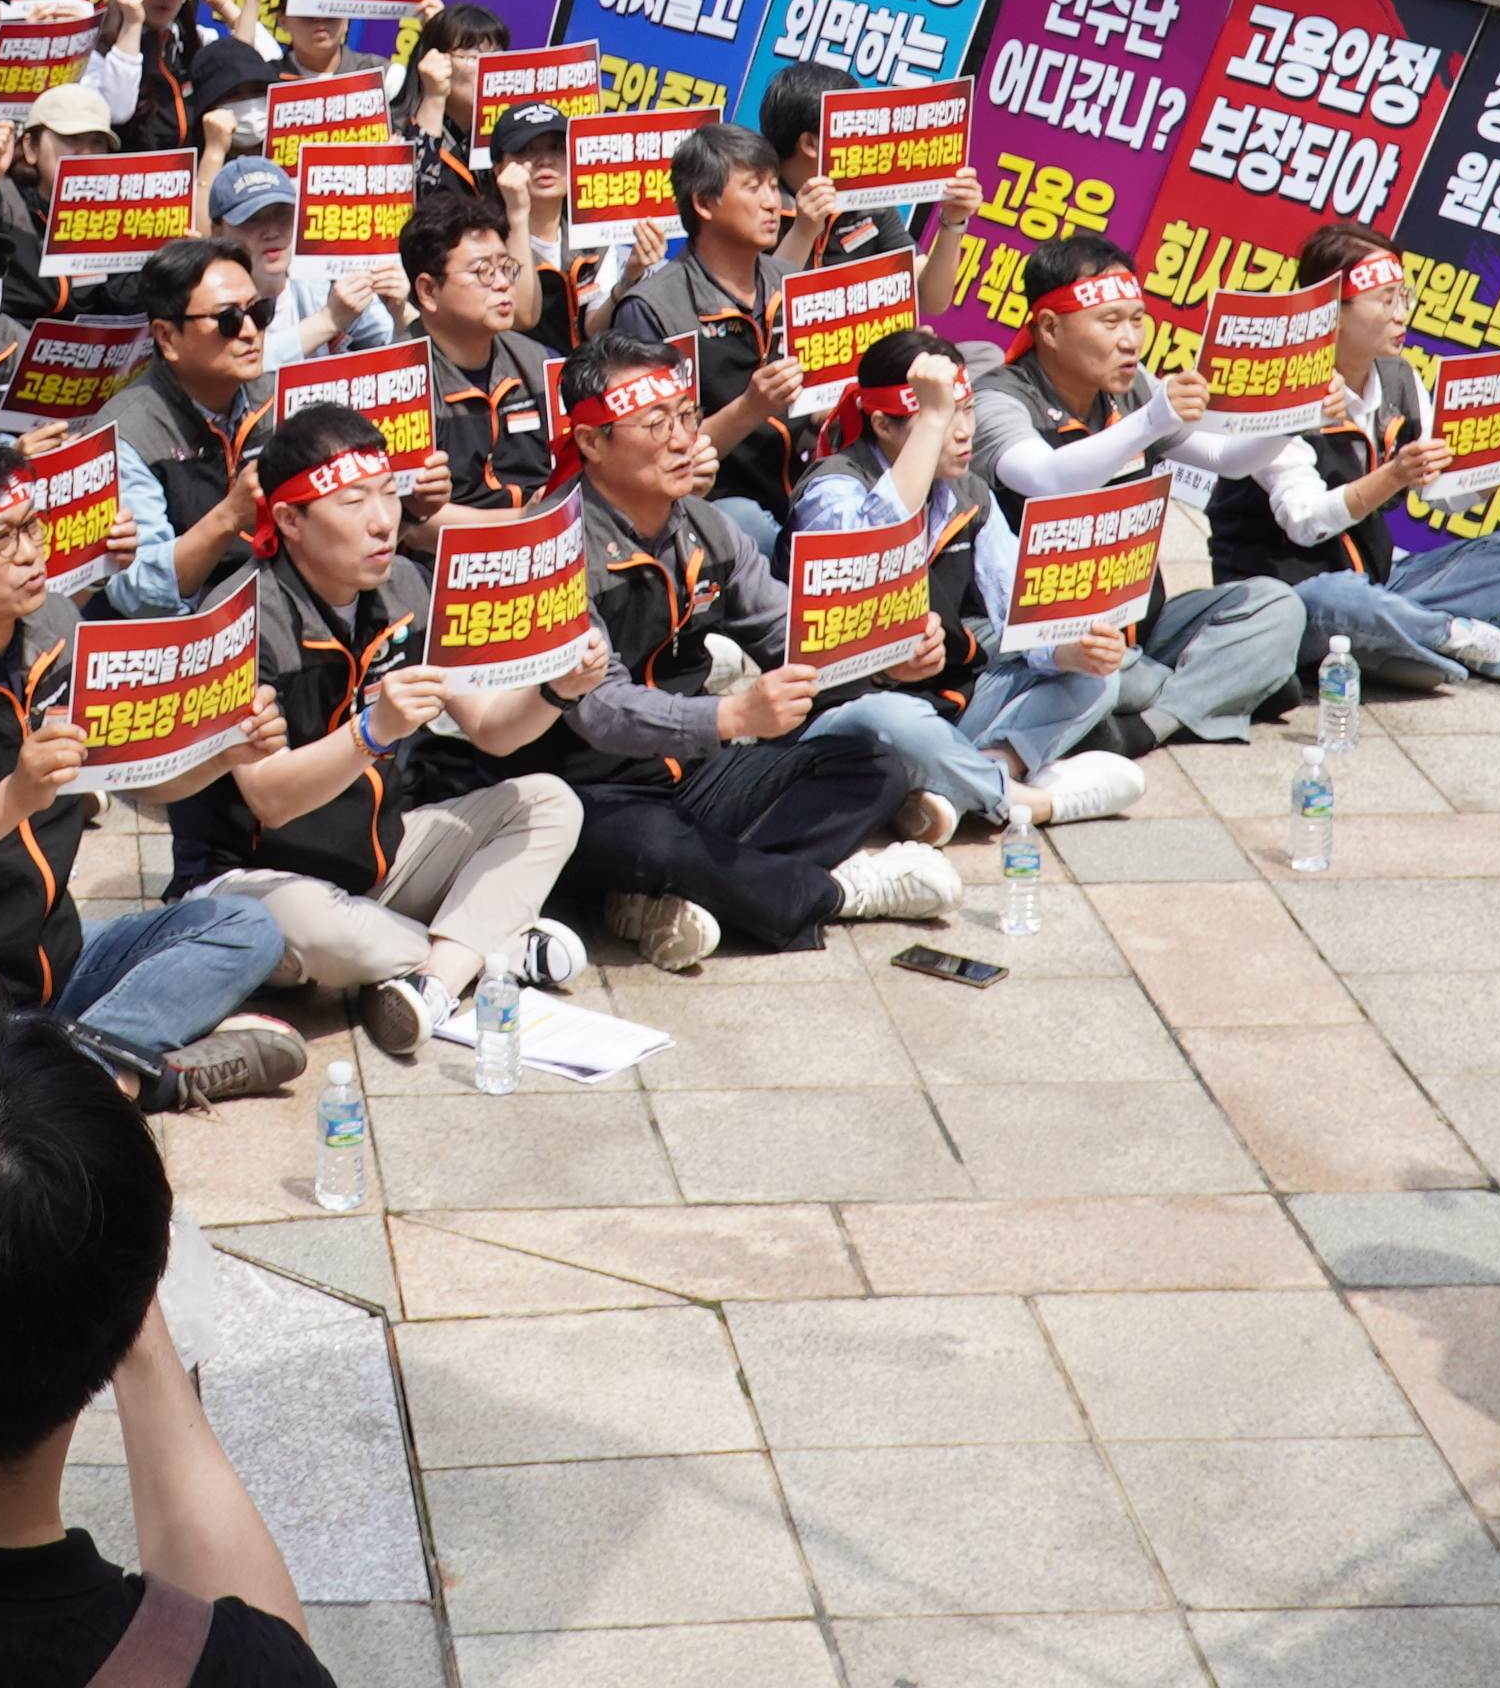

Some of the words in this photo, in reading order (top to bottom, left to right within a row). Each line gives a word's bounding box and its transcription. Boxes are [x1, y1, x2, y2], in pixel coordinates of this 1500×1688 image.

[1225, 2, 1441, 126] 고용안정
[829, 106, 888, 137] 대주주만을
[891, 104, 917, 130] 위한
[988, 37, 1188, 152] 어디갔니?
[828, 143, 892, 179] 고용보장
[896, 134, 963, 170] 약속하라!
[1188, 95, 1401, 226] 보장되야
[61, 172, 119, 202] 대주주만을
[122, 174, 143, 199] 위한
[977, 152, 1116, 241] 고용은
[55, 208, 119, 241] 고용보장
[122, 204, 188, 238] 약속하라!
[1029, 515, 1090, 556] 대주주만을
[1093, 511, 1118, 540] 위한
[1019, 560, 1093, 609] 고용보장
[1095, 543, 1157, 591] 약속하라!
[85, 651, 177, 690] 대주주만을
[181, 644, 213, 676] 위한
[84, 691, 181, 747] 고용보장
[183, 658, 255, 722] 약속하라!
